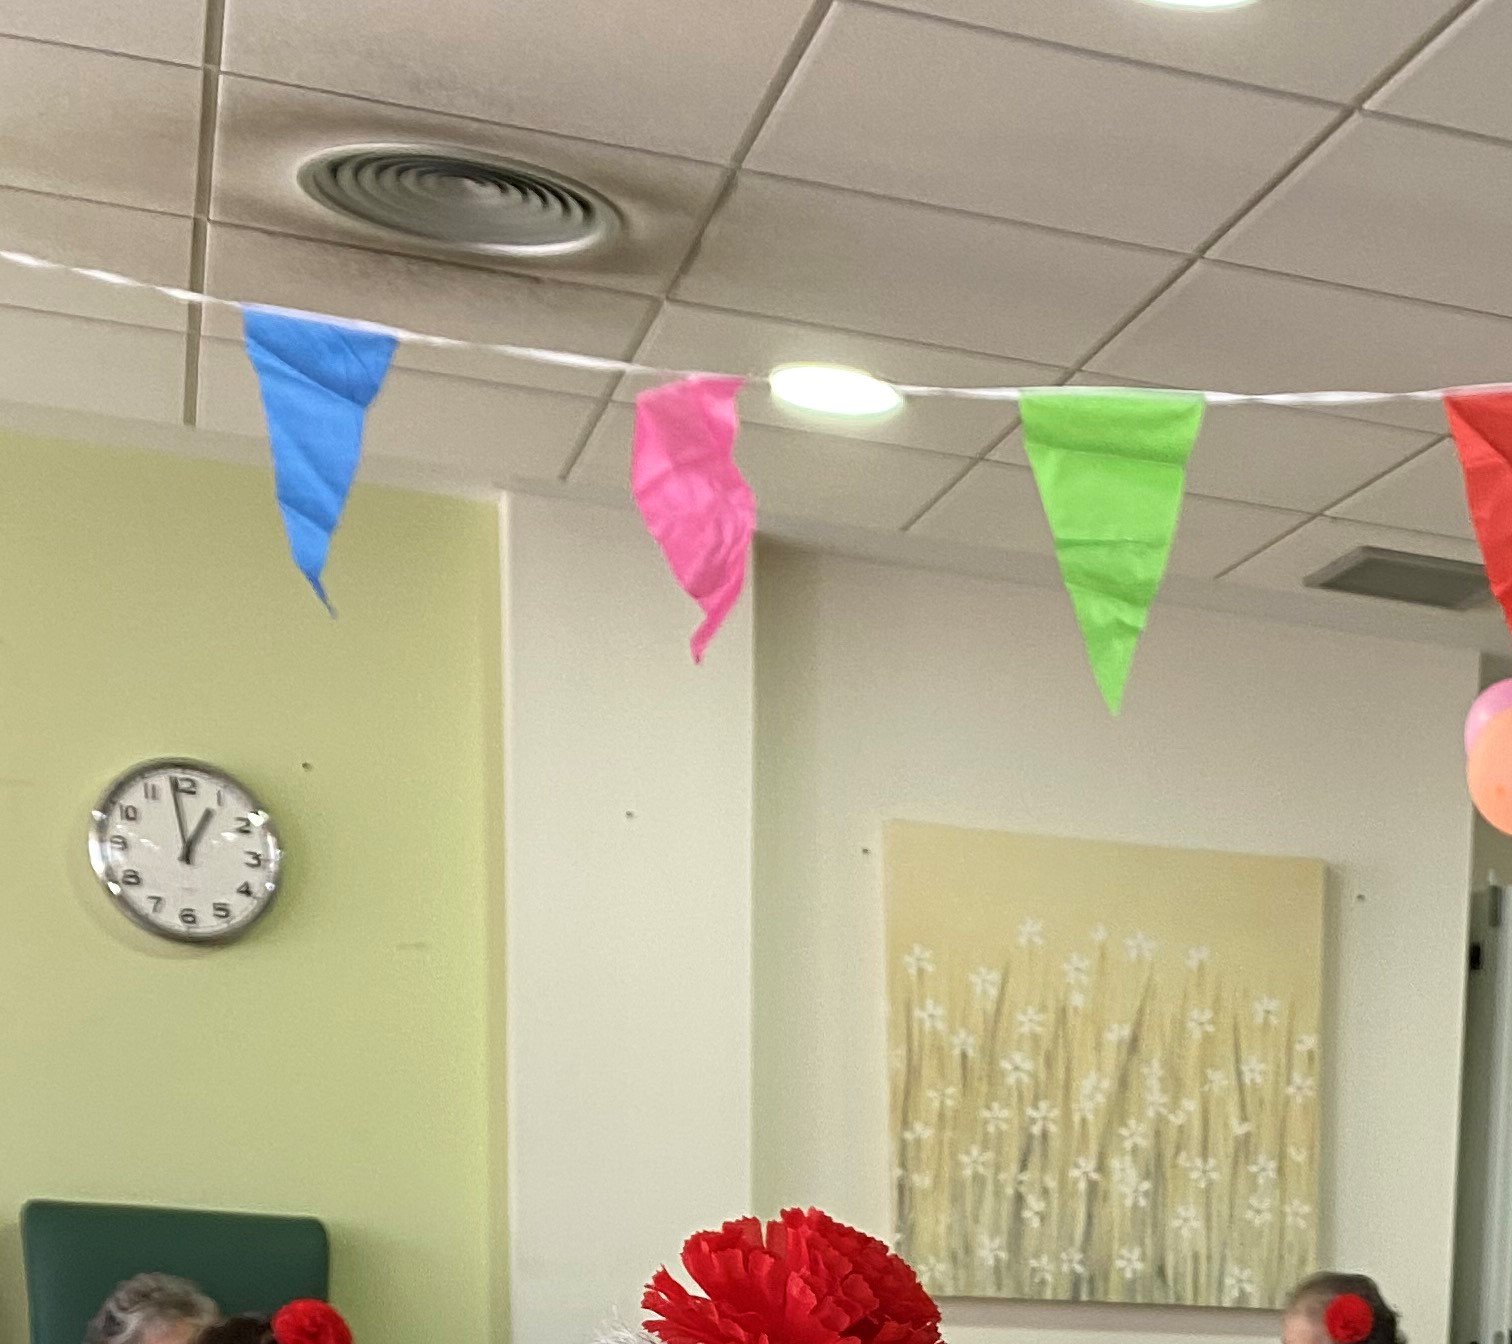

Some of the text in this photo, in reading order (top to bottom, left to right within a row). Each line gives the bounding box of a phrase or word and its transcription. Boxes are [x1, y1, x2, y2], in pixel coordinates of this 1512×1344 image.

[143, 782, 158, 800] 11
[216, 790, 222, 806] 1
[120, 804, 138, 820] 10
[236, 816, 252, 834] 2
[244, 851, 262, 868] 3
[122, 869, 141, 885] 8
[237, 881, 252, 897] 4
[147, 895, 163, 913] 7
[213, 903, 230, 918] 5
[179, 908, 197, 924] 6
